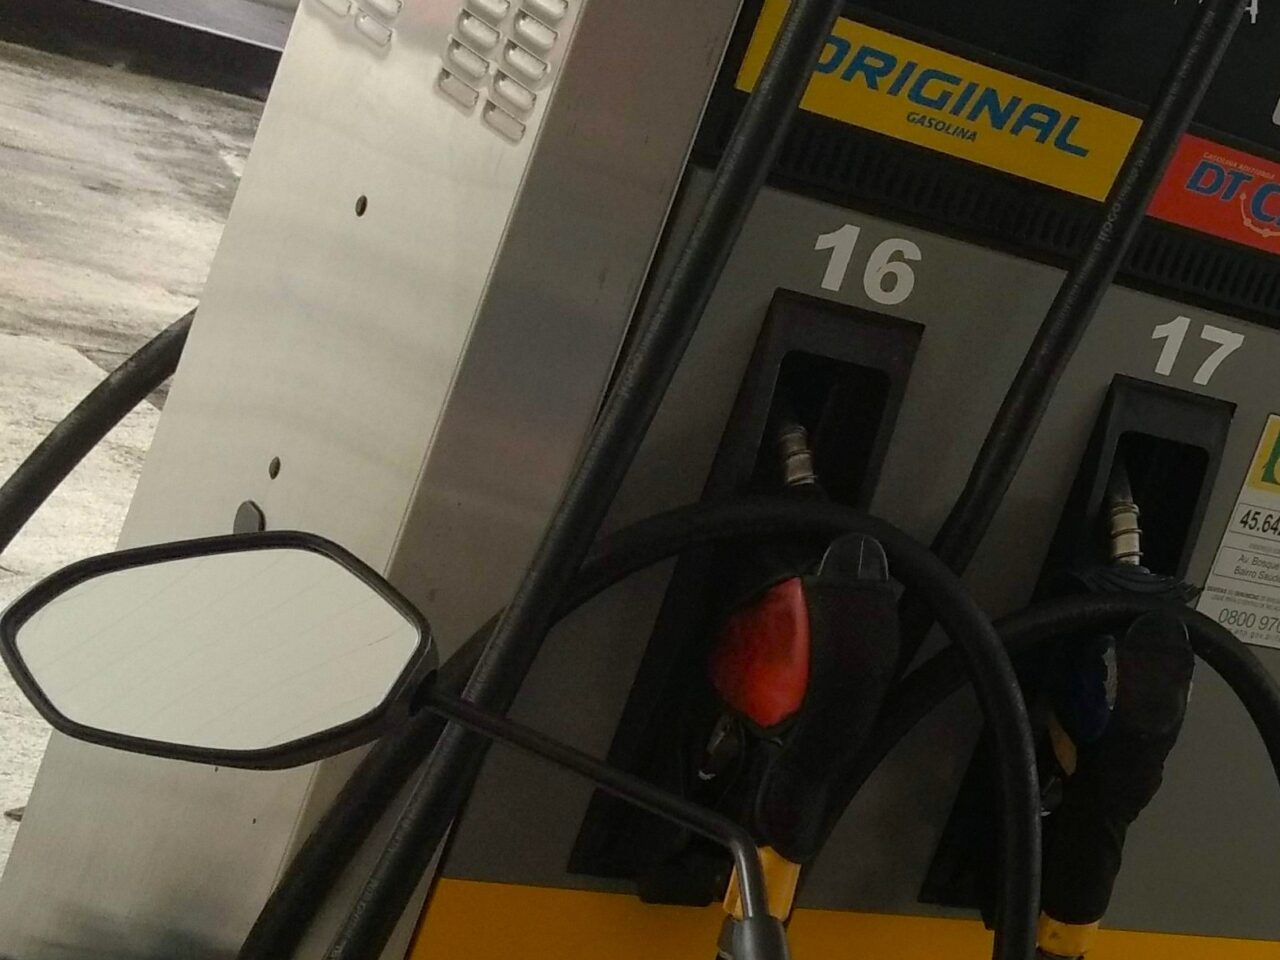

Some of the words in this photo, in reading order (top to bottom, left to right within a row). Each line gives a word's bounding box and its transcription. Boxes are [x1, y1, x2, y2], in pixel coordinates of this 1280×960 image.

[813, 35, 1090, 158] ORIGINAL
[905, 111, 978, 142] GASOLINA
[1186, 160, 1254, 202] DT
[813, 223, 922, 305] 16
[1150, 315, 1245, 386] 17
[1219, 608, 1255, 629] 0800
